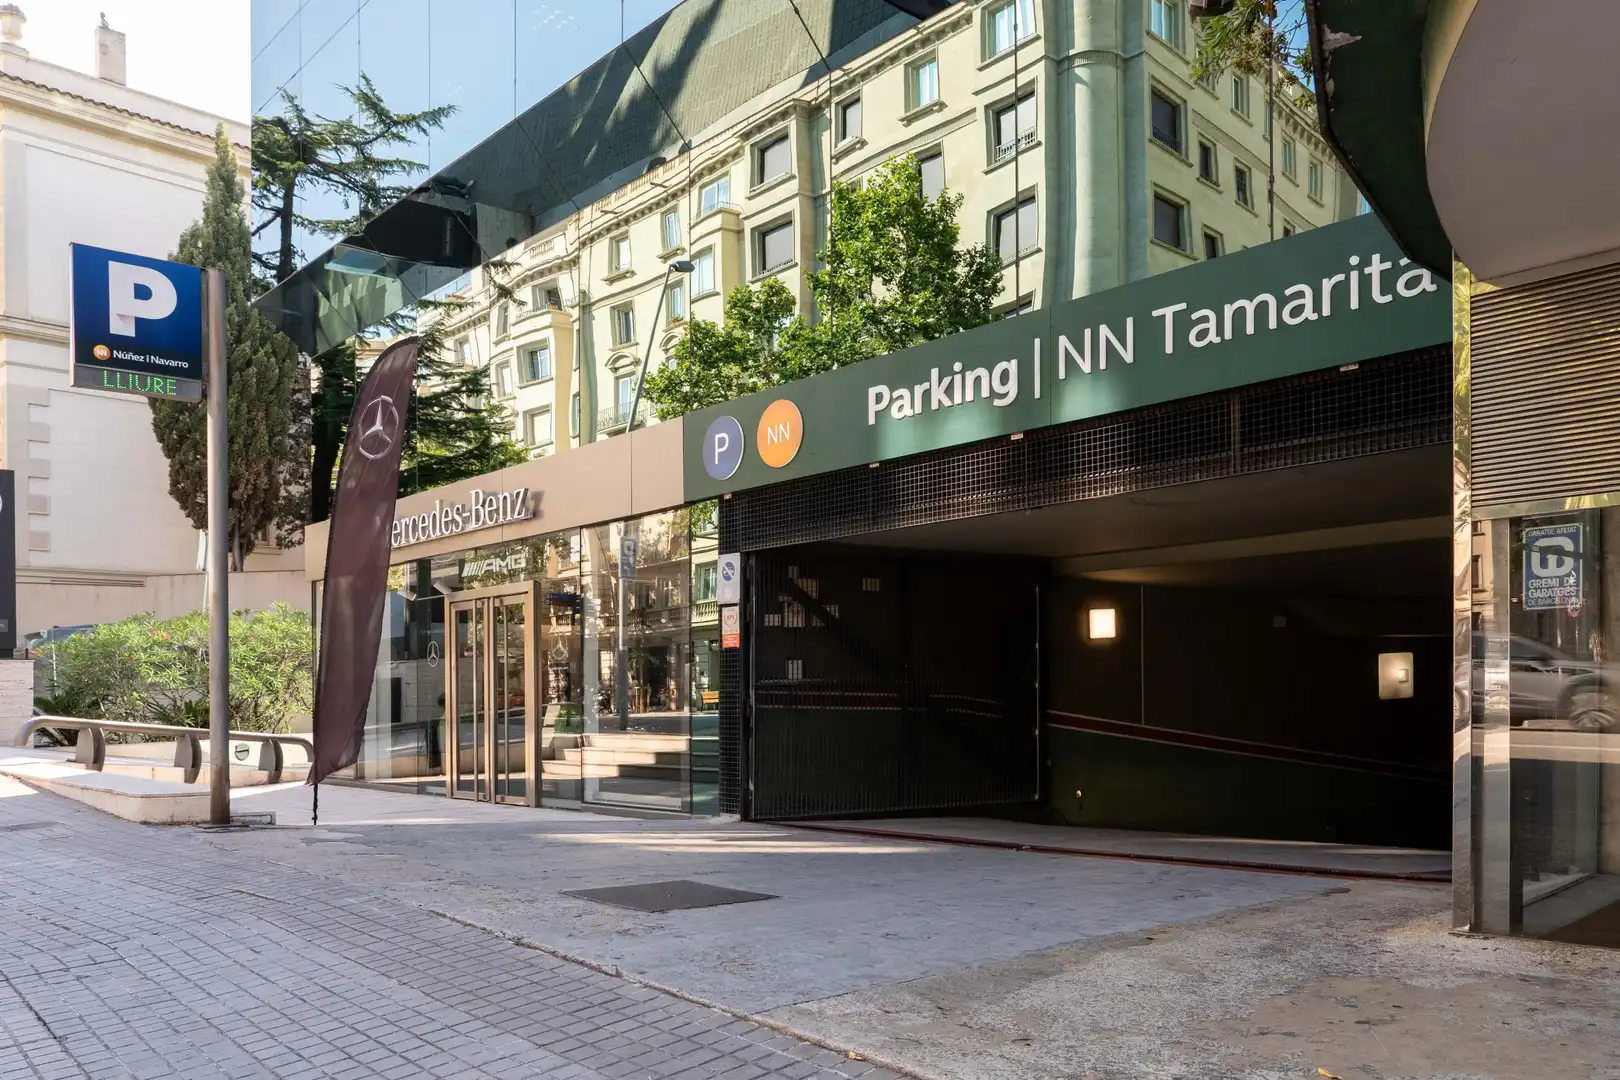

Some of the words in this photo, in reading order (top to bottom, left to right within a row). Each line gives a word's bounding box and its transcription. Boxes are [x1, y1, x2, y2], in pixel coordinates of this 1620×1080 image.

[108, 260, 178, 337] P
[113, 350, 145, 362] Núñez
[150, 355, 189, 369] Navarro
[868, 358, 1019, 426] Parking
[1058, 316, 1134, 380] NN
[103, 370, 177, 396] LLIURE
[767, 421, 791, 446] NN
[714, 432, 729, 465] P
[391, 487, 529, 547] ercedes-Benz
[1528, 577, 1560, 589] GREMI
[1528, 587, 1577, 599] GARATGES
